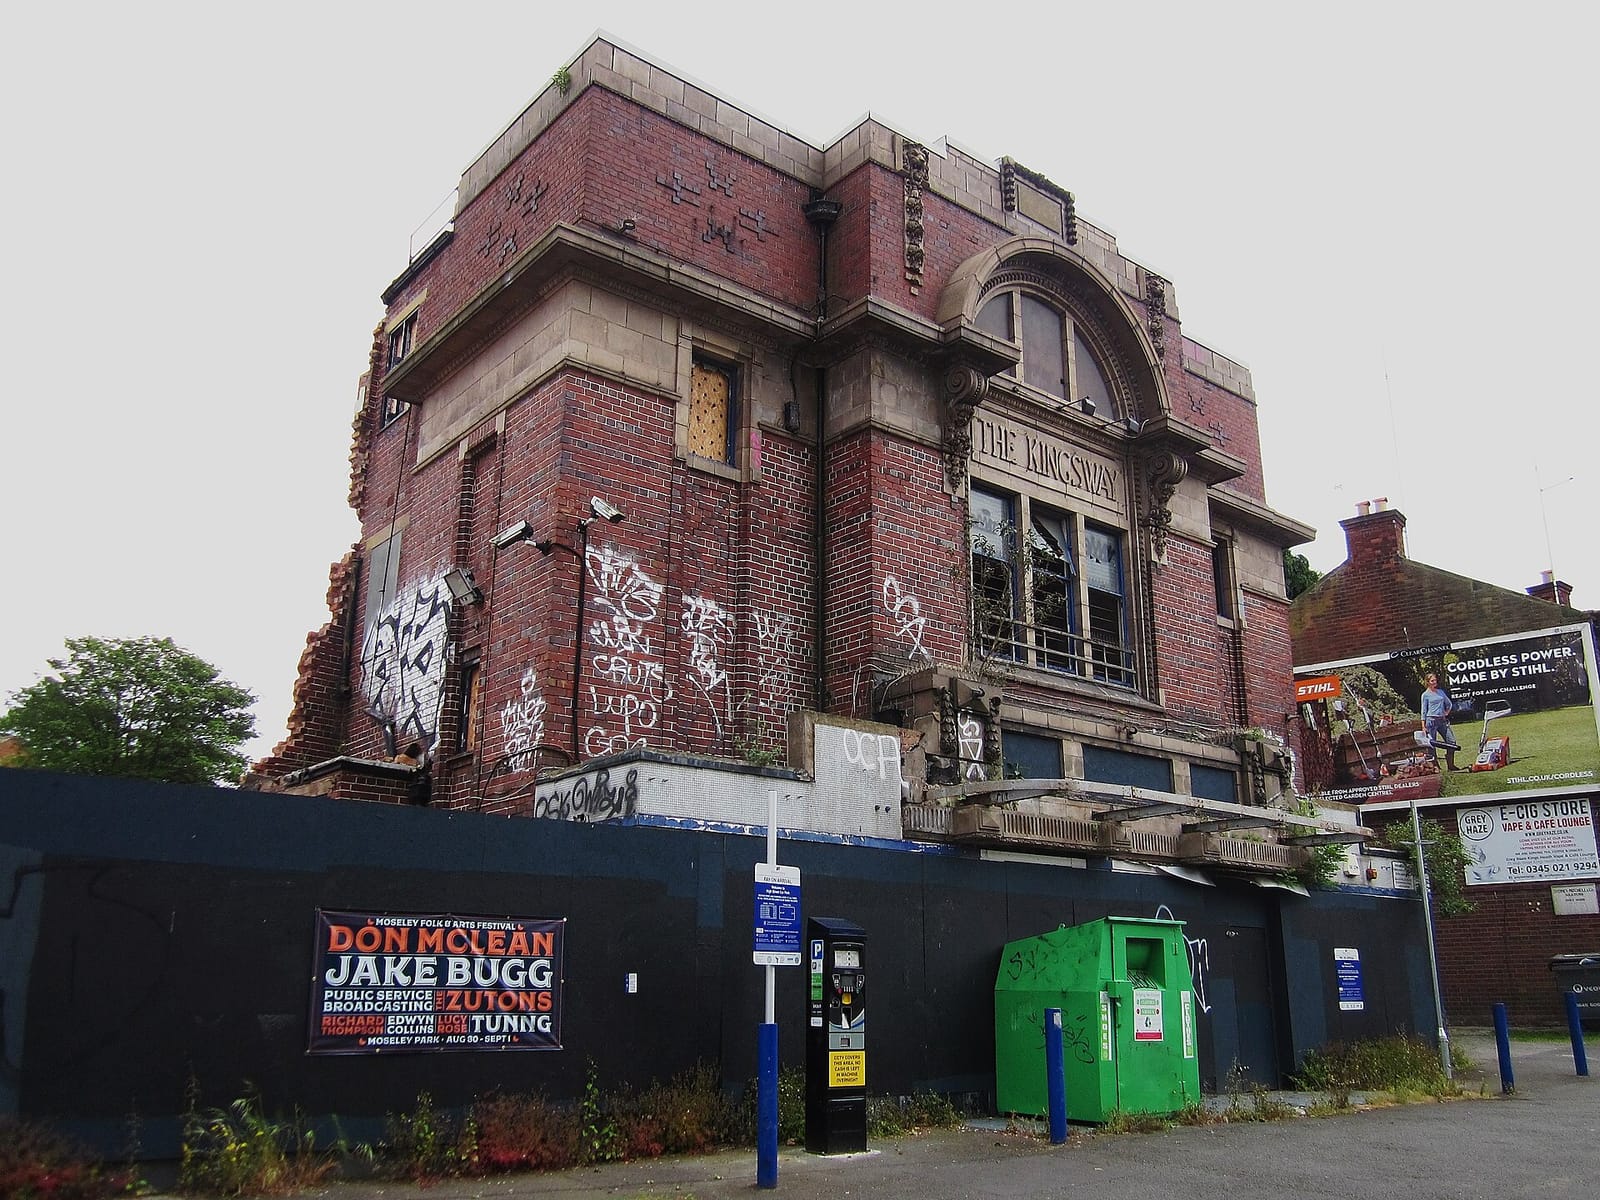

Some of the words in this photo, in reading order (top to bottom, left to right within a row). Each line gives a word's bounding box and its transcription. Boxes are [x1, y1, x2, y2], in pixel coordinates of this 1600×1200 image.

[974, 417, 1017, 465] THE
[1025, 431, 1120, 502] KINGSWAY
[1447, 654, 1518, 673] CORDLESS
[1521, 647, 1577, 663] POWER.
[1448, 671, 1487, 686] MADE
[1490, 668, 1508, 680] BY
[1511, 663, 1555, 677] STIHL.
[1297, 682, 1335, 696] STIHL
[1451, 691, 1471, 699] READY
[1500, 683, 1536, 693] CHALLENGE
[1507, 770, 1593, 784] STIHL.CO.UK/CORDLESS
[1332, 789, 1347, 797] FROM
[1348, 786, 1378, 794] APPROVED
[1394, 781, 1420, 789] DEALERS
[1343, 791, 1367, 799] GARDEN
[1500, 804, 1538, 820] E-CIG
[1542, 800, 1589, 818] STORE
[1464, 814, 1487, 825] GREY
[1502, 822, 1522, 832] VAPE
[1525, 821, 1532, 830] &
[1557, 816, 1591, 828] LOUNGE
[1466, 824, 1488, 834] HAZE
[1507, 866, 1524, 875] Tel:
[1526, 864, 1549, 873] 0345
[1552, 863, 1570, 872] 021
[1574, 861, 1598, 870] 9294
[376, 918, 419, 927] MOSELEY
[420, 919, 444, 927] FOLK
[452, 920, 476, 929] ARTS
[477, 921, 516, 930] FESTIVAL
[328, 925, 410, 953] DON
[416, 928, 555, 957] MCLEAN
[814, 943, 822, 957] P
[325, 955, 438, 987] JAKE
[446, 957, 553, 988] BUGG
[324, 990, 374, 1000] PUBLIC
[376, 990, 433, 1000] SERVICE
[435, 990, 443, 1011] THE
[446, 990, 553, 1012] ZUTONS
[323, 1001, 433, 1013] BROADCASTING
[322, 1015, 385, 1026] RICHARD
[387, 1015, 434, 1025] EDWYN
[437, 1015, 469, 1024] LUCY
[471, 1015, 552, 1033] TUNNG
[321, 1026, 384, 1035] THOMPSON
[387, 1025, 434, 1034] COLLINS
[437, 1024, 467, 1034] ROSE
[367, 1036, 414, 1045] MOSELEY
[414, 1035, 440, 1044] PARK
[446, 1035, 466, 1043] AUG
[484, 1035, 507, 1043] SEPT
